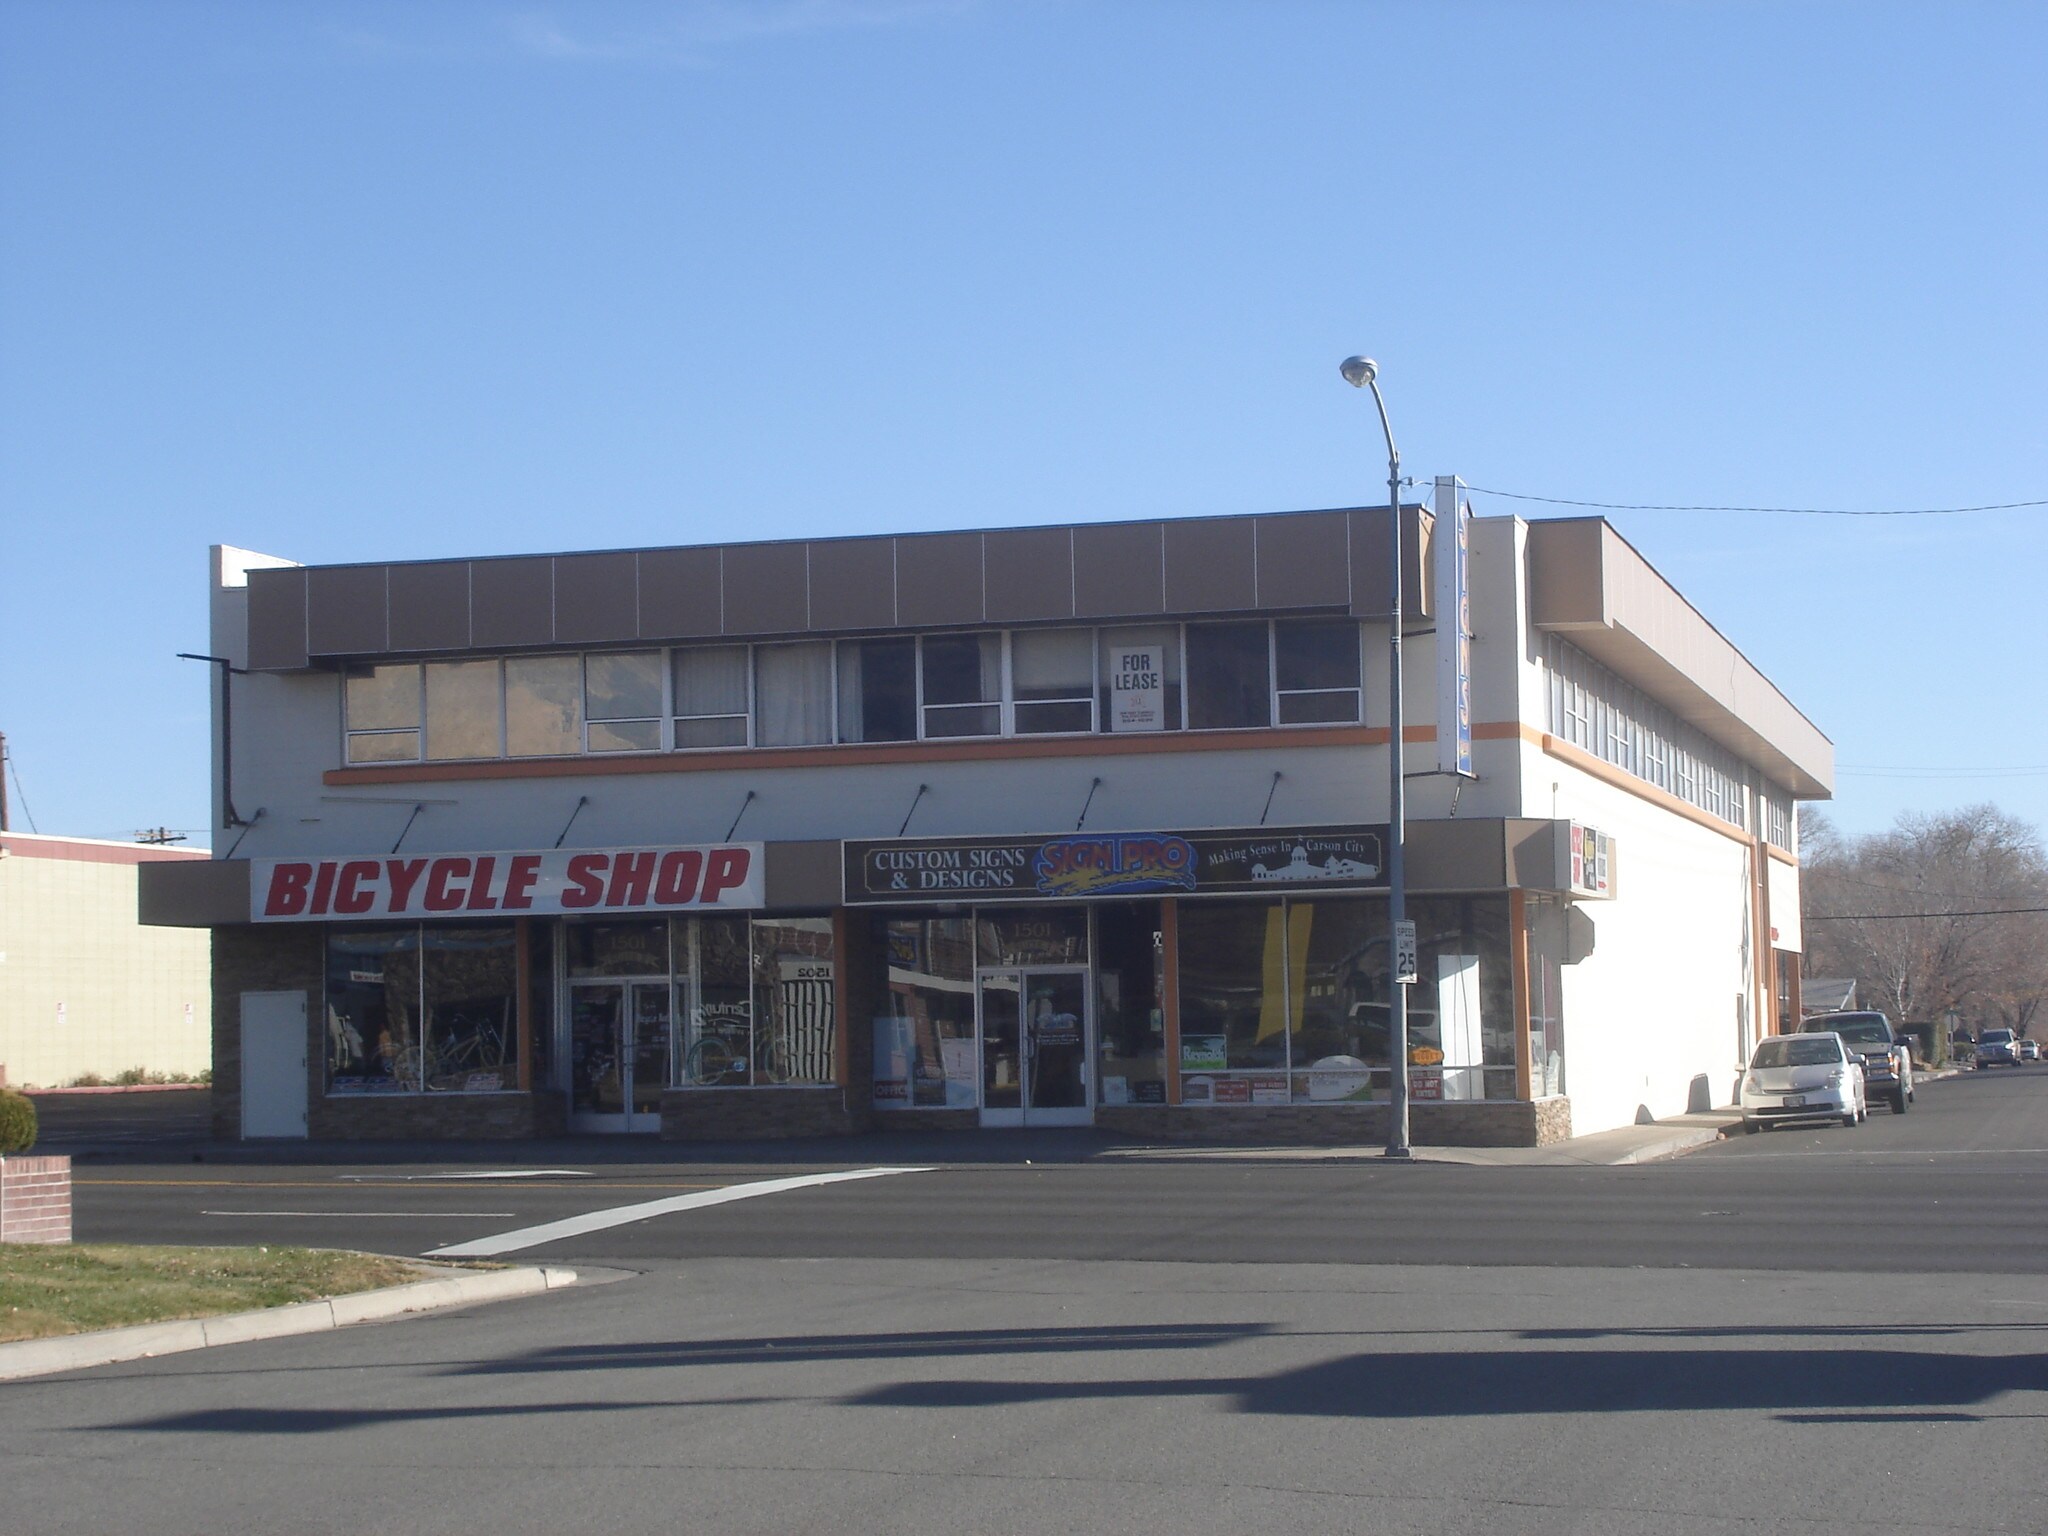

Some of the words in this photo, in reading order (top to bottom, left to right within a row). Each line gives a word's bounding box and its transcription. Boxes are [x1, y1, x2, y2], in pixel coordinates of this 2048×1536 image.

[1459, 501, 1470, 730] SIGNS
[1122, 654, 1150, 671] FOR
[1115, 673, 1159, 691] LEASE
[875, 850, 961, 870] CUSTOM
[969, 849, 1025, 867] SIGNS
[1042, 841, 1112, 876] SIGN
[1123, 838, 1189, 871] PRO
[1208, 848, 1247, 866] Making
[1249, 843, 1277, 857] Sense
[1281, 840, 1291, 852] In
[1306, 839, 1341, 852] Carson
[1345, 840, 1365, 857] City
[264, 855, 541, 916] BICYCLE
[560, 848, 751, 909] SHOP
[891, 871, 909, 889] &
[920, 868, 1014, 889] DESIGNS
[1014, 921, 1051, 938] 1501
[1398, 952, 1415, 975] 25
[1424, 1080, 1439, 1088] NOT
